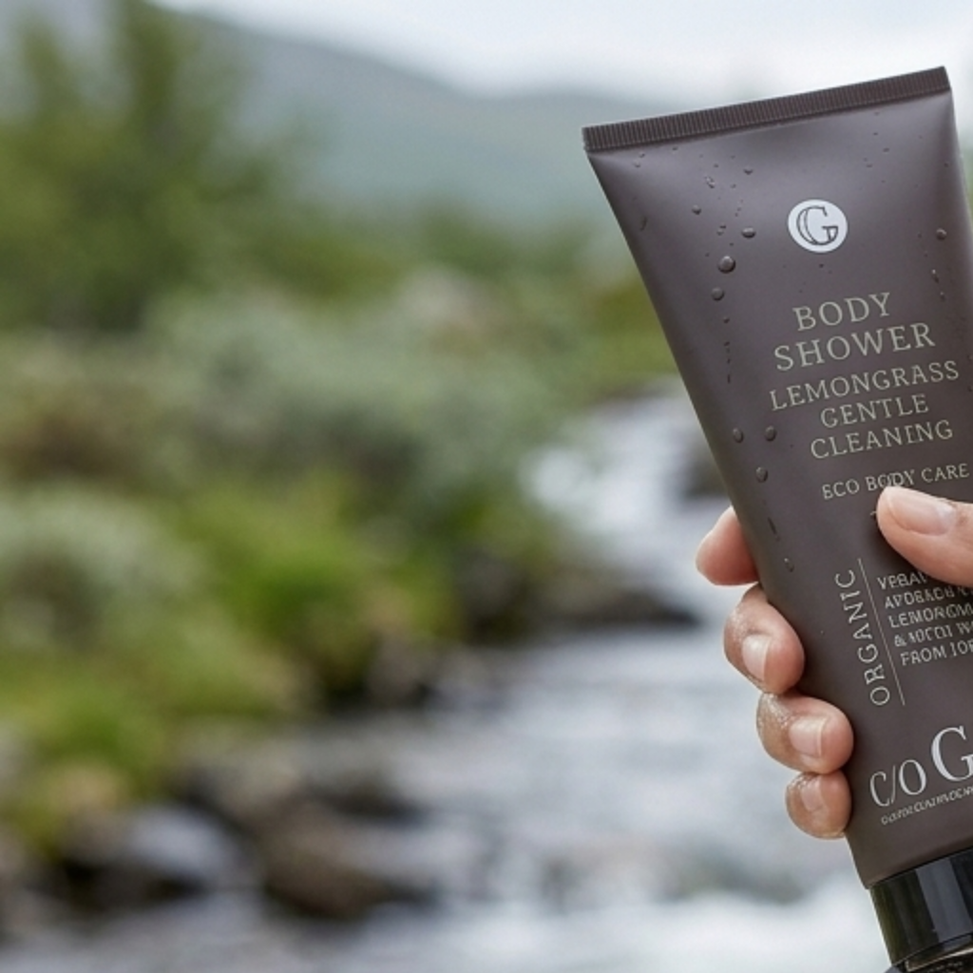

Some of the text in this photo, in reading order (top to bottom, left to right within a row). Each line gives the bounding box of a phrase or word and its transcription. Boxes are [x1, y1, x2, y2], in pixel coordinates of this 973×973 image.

[792, 292, 891, 331] BODY
[774, 322, 935, 371] SHOWER
[769, 360, 959, 411] LEMONGRASS
[820, 393, 929, 428] GENTLE
[810, 419, 953, 459] CLEANING
[821, 463, 970, 500] ECO BODY CARE
[835, 569, 890, 706] ORGANIC
[900, 645, 947, 666] FROM
